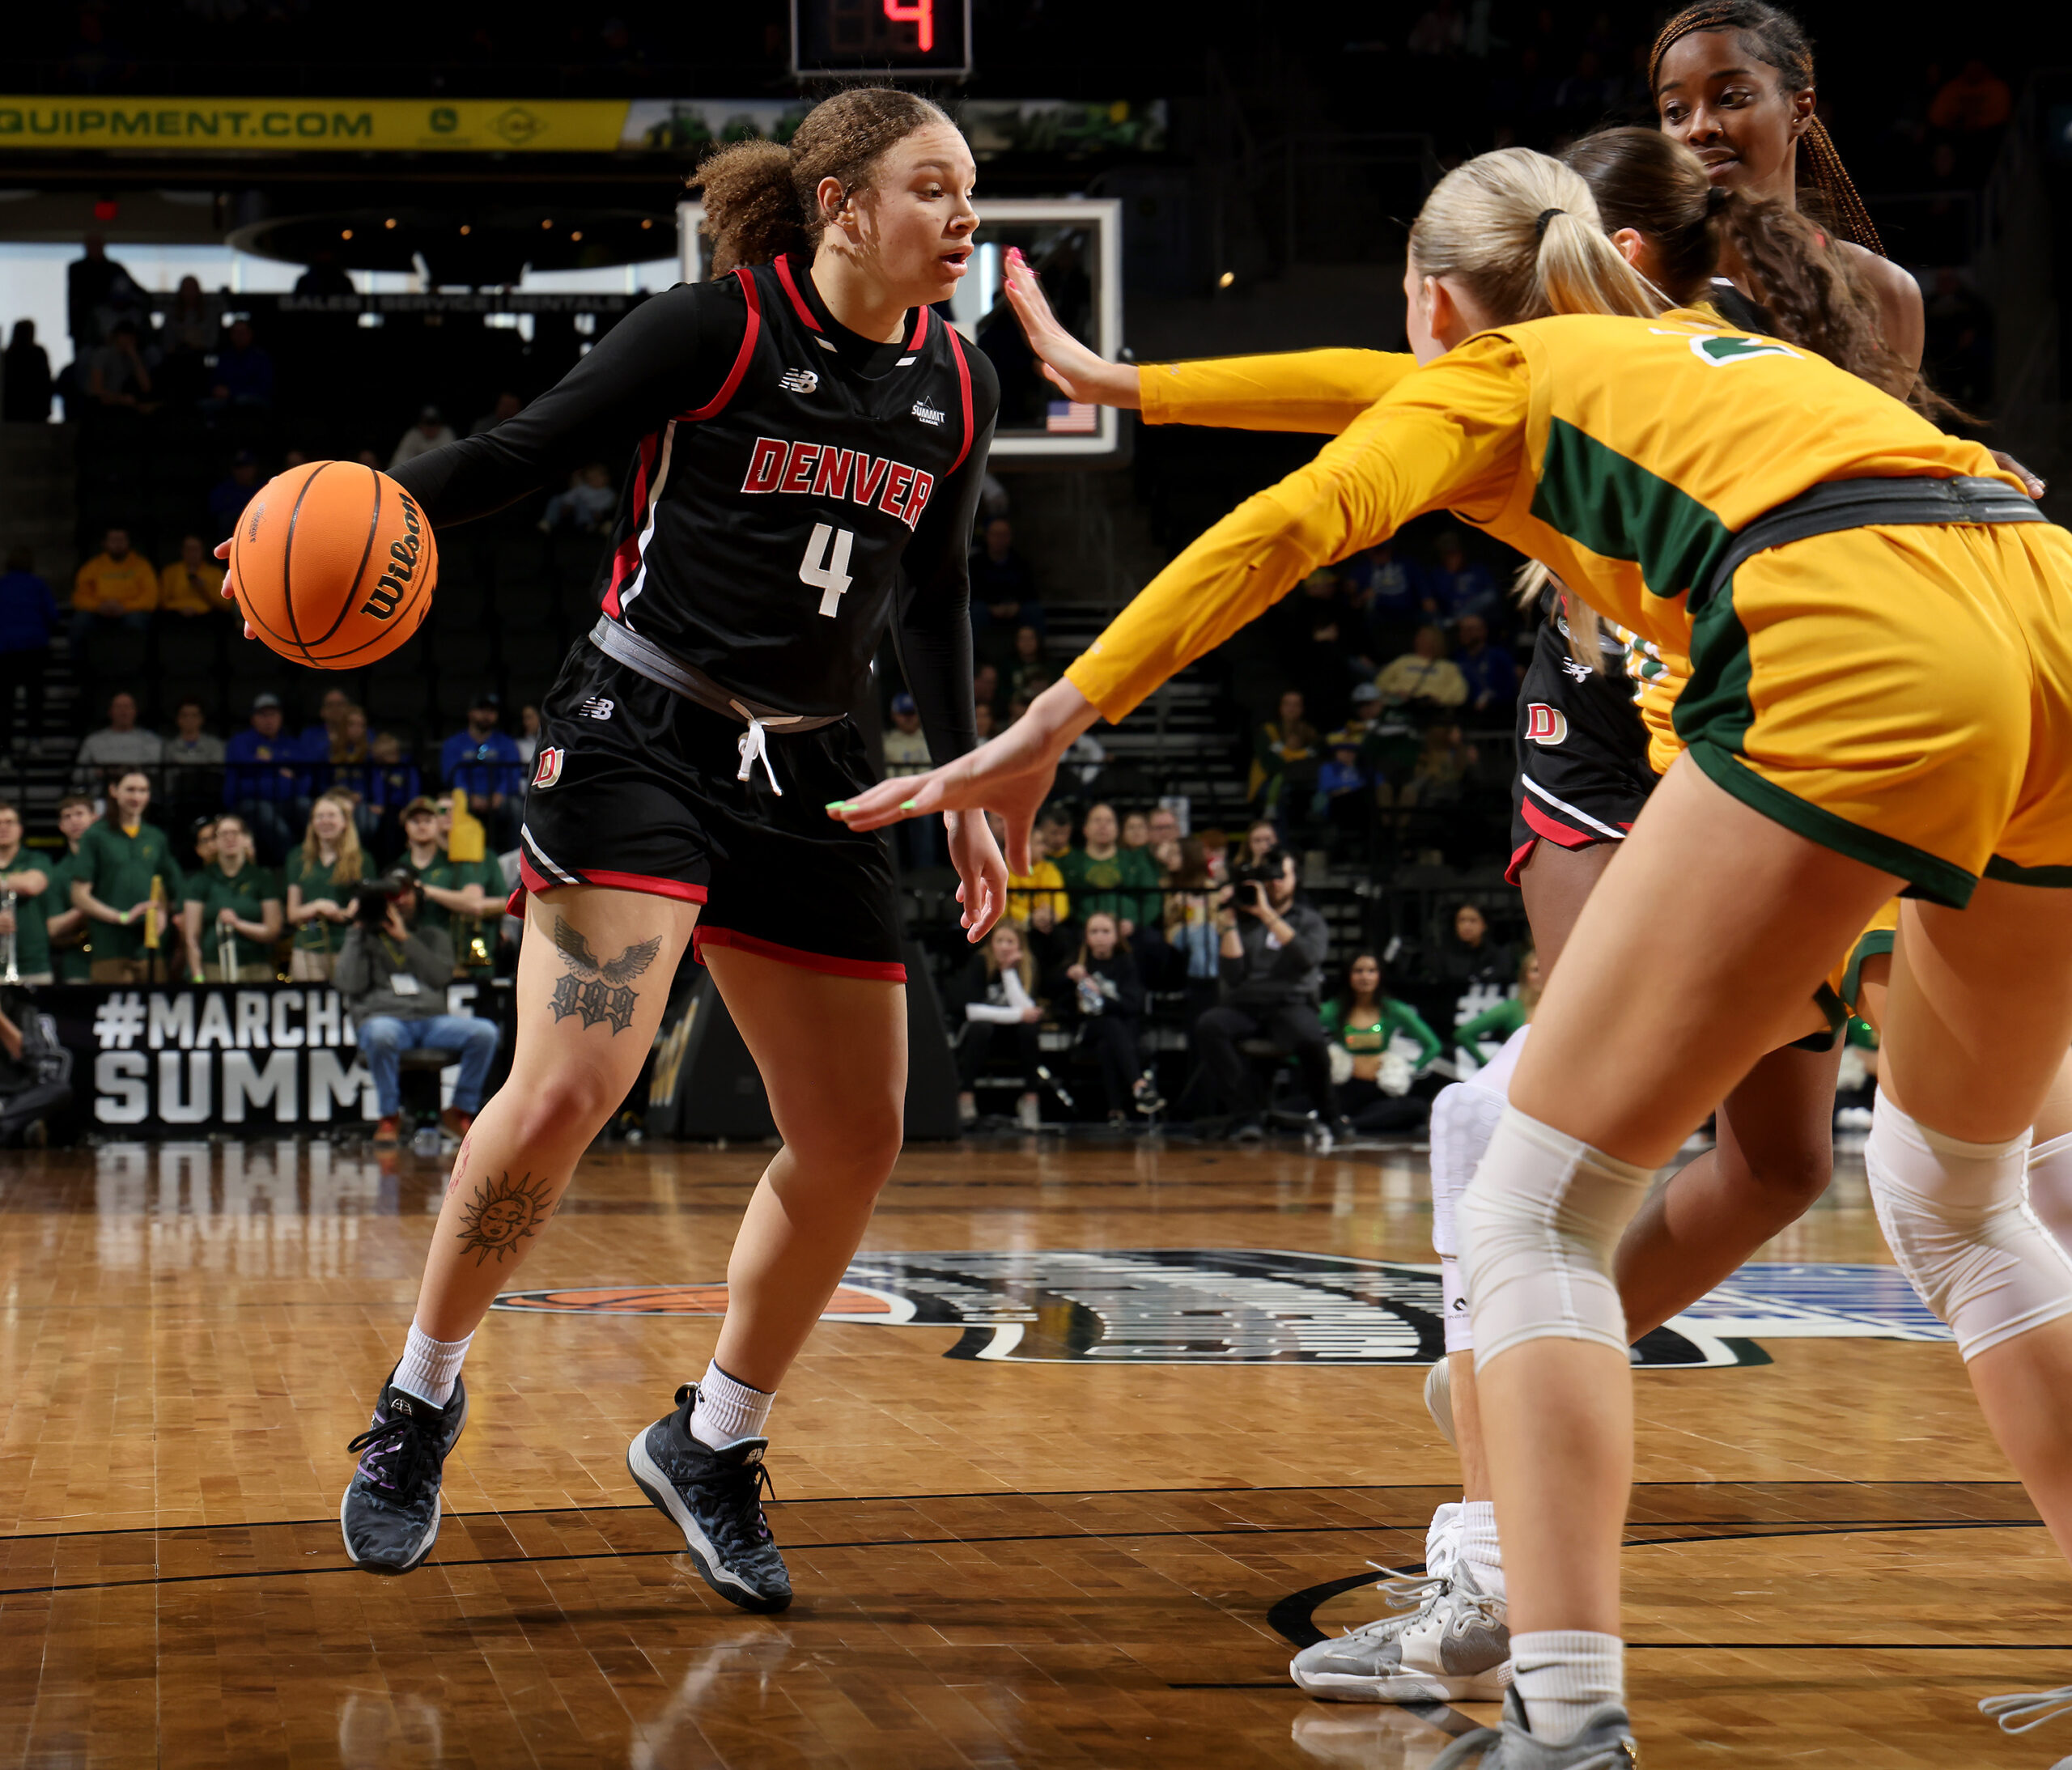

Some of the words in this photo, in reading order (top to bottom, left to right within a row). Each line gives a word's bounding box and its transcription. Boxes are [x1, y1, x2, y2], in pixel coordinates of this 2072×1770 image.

[911, 405, 945, 424] SUMMIT
[740, 436, 935, 533] DENVER
[359, 491, 422, 622] Wilson
[799, 522, 855, 618] 4
